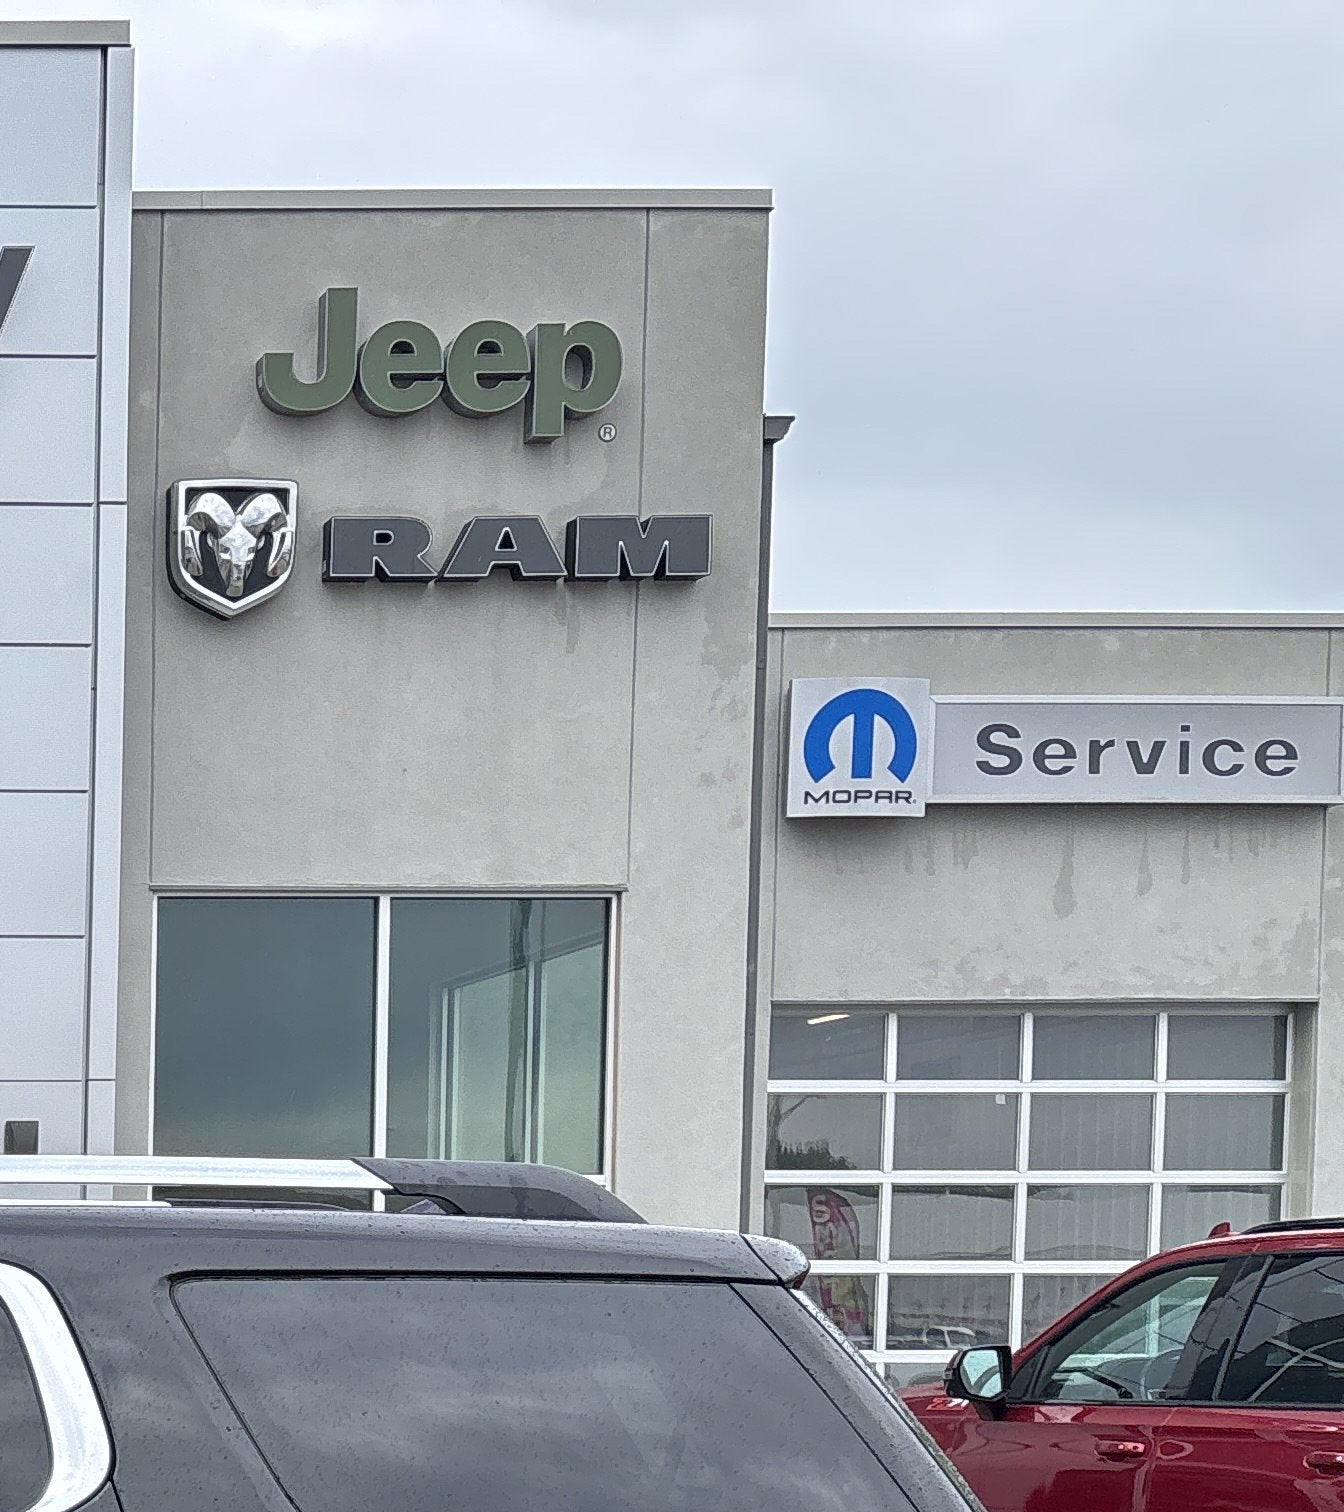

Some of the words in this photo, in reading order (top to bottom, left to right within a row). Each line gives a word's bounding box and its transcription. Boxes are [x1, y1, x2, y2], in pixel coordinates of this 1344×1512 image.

[256, 287, 624, 444] Jeep
[322, 514, 713, 583] RAM
[975, 723, 1300, 777] Service
[803, 789, 913, 805] MOPAR
